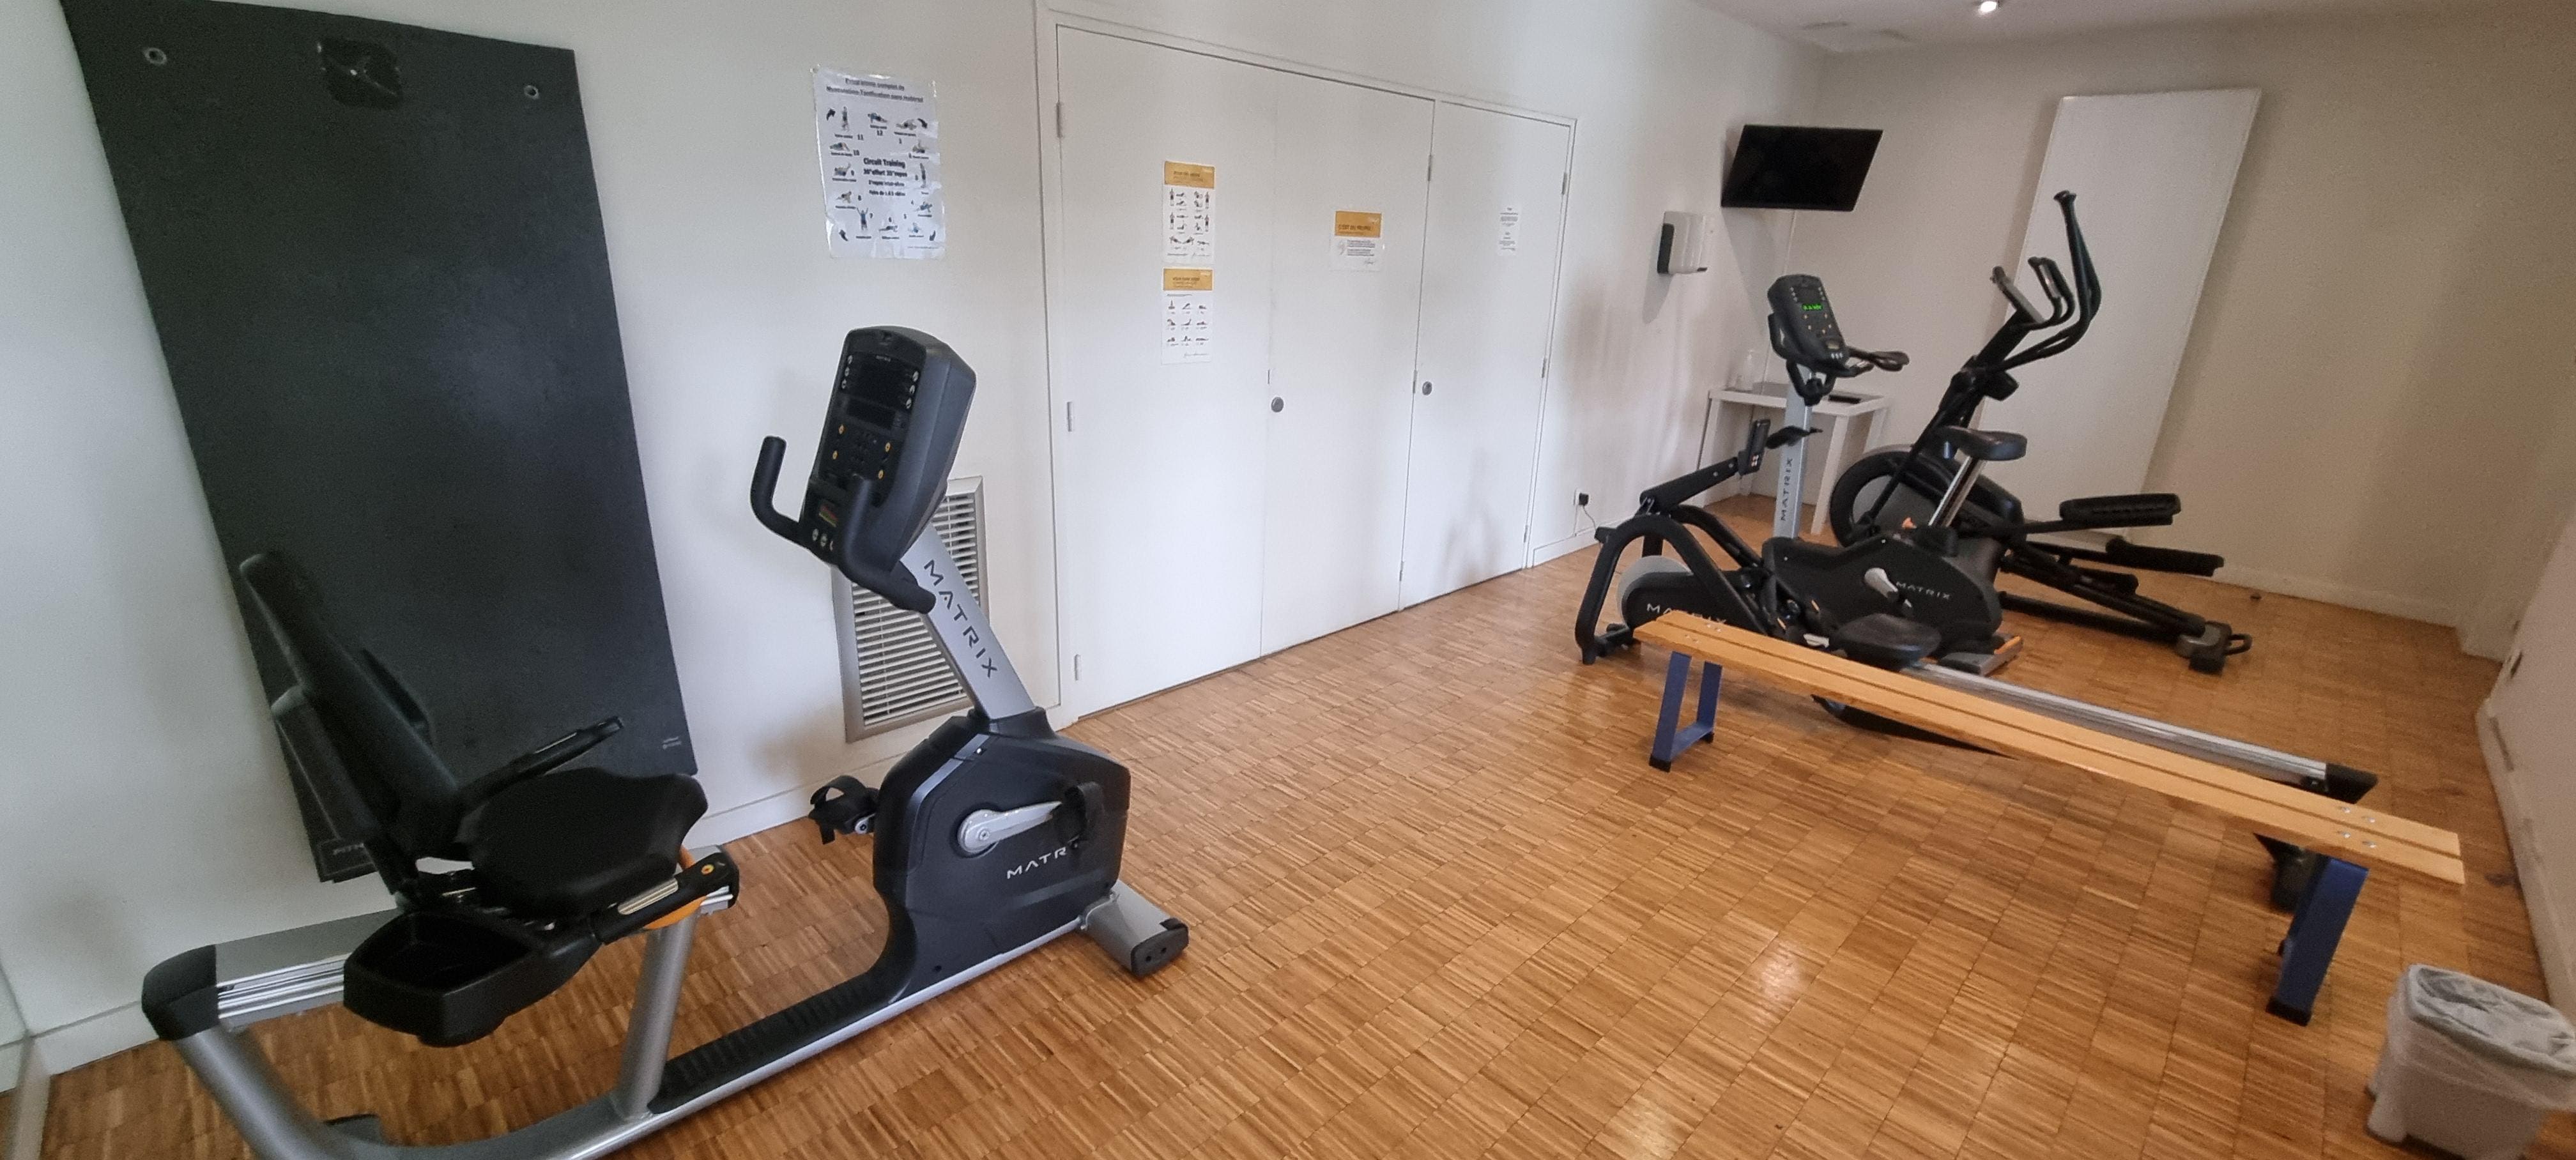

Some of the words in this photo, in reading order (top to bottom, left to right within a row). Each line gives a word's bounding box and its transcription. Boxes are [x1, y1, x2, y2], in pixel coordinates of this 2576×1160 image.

[883, 158, 905, 169] Training
[1781, 458, 1793, 521] MATRIX
[1896, 581, 1951, 600] MATRIX
[924, 560, 998, 678] MATRIX
[1007, 846, 1068, 880] MATR
